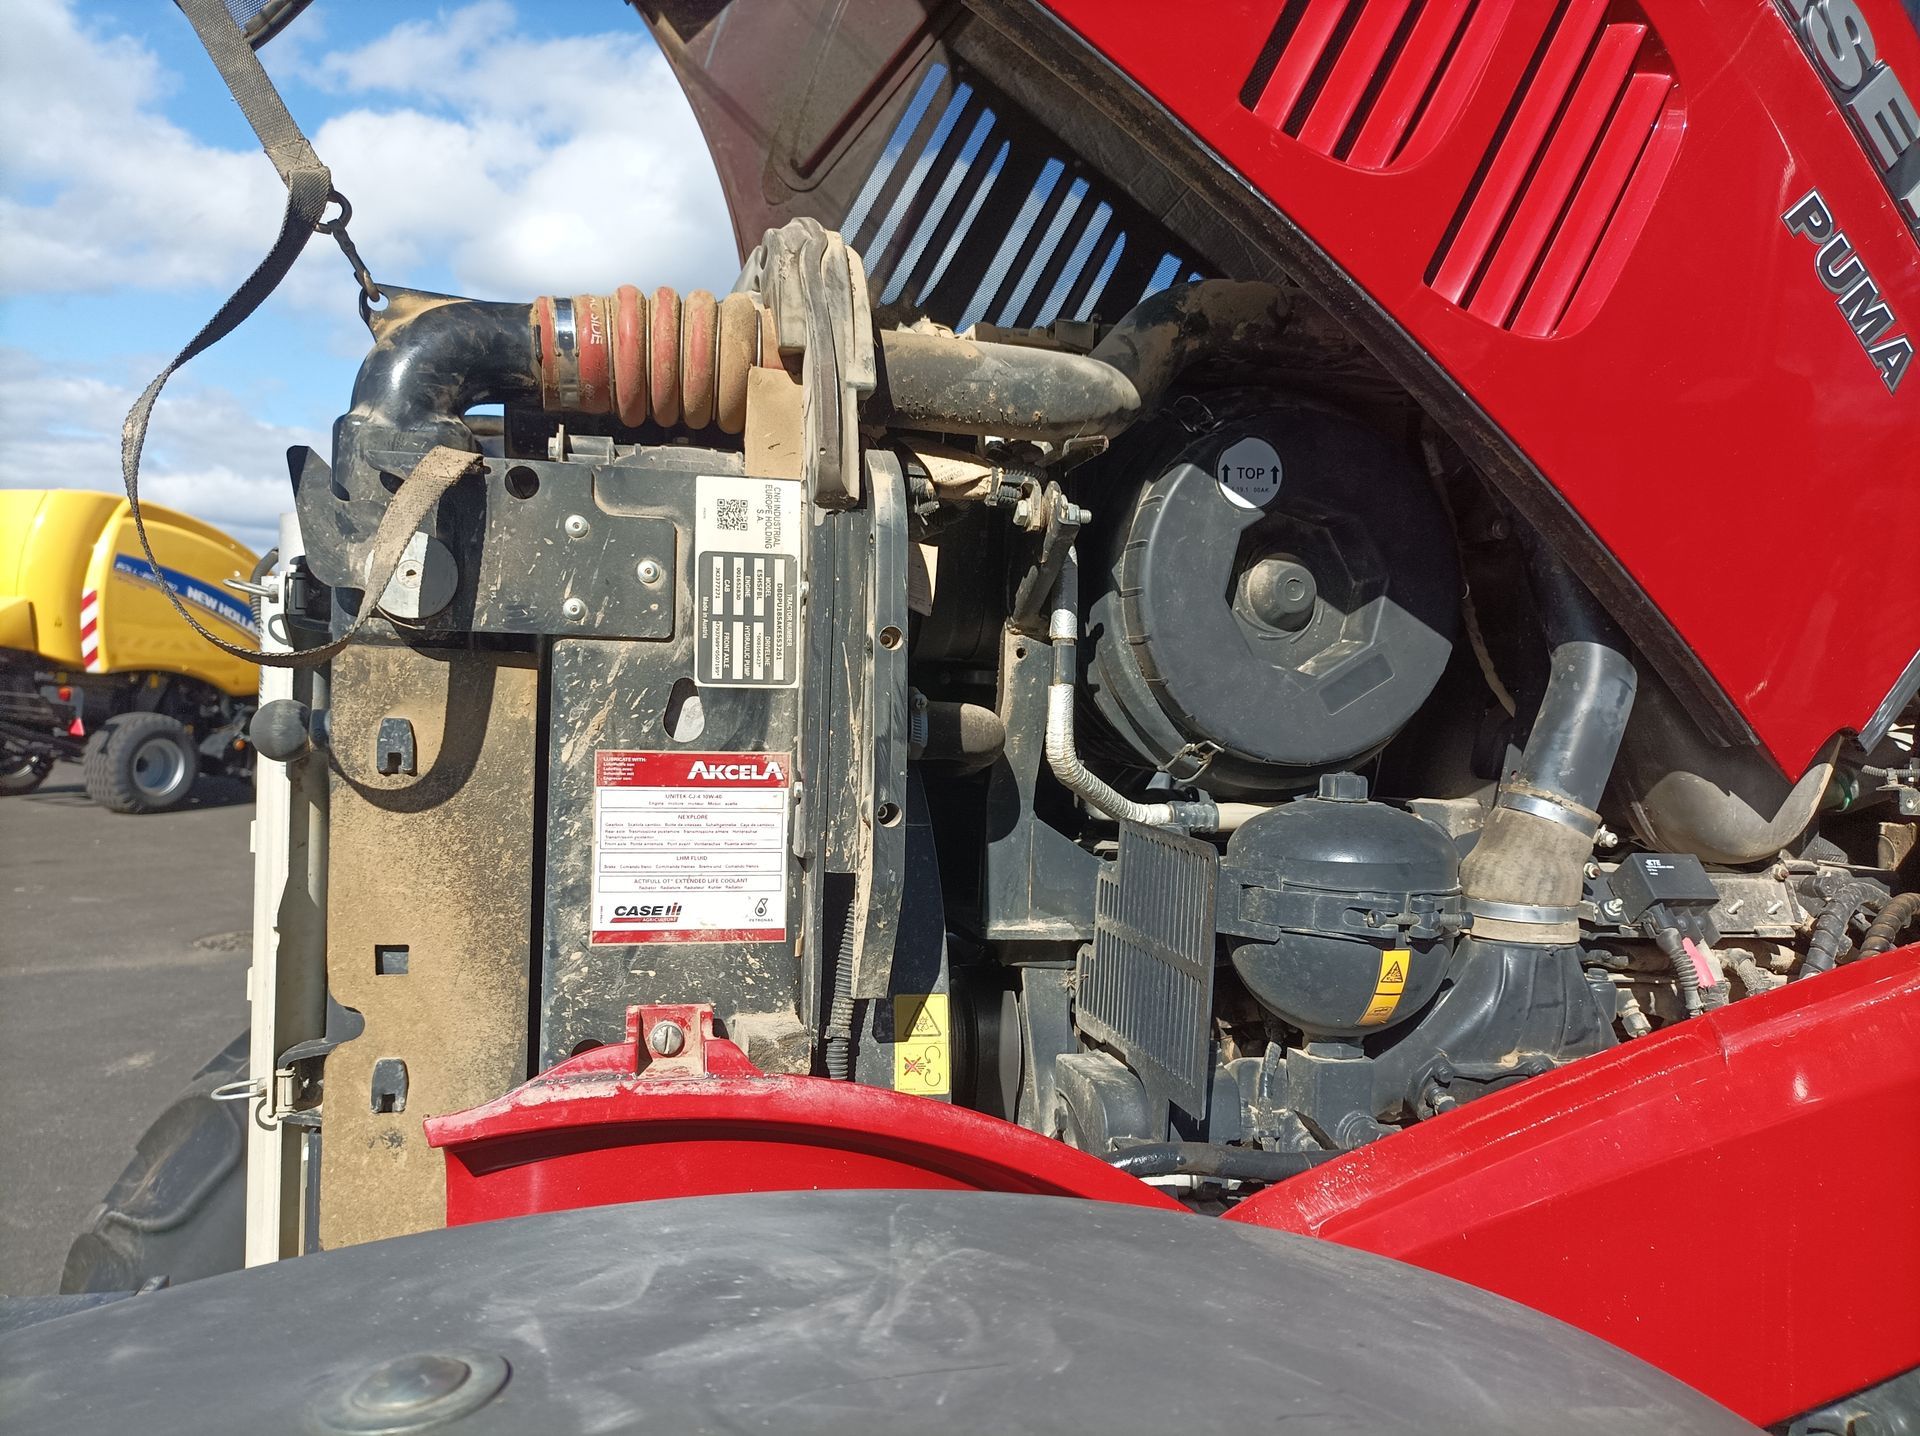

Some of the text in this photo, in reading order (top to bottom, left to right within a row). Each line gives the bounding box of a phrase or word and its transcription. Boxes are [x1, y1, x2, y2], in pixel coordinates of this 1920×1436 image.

[1781, 187, 1916, 396] PUMA
[1237, 467, 1265, 480] TOP
[756, 509, 764, 524] S.A.
[765, 484, 773, 549] EUROPE HOLDING
[773, 487, 781, 547] CNH INDUSTRIAL
[187, 585, 218, 610] NEW
[687, 761, 784, 781] AKCELA
[614, 905, 664, 916] CASE
